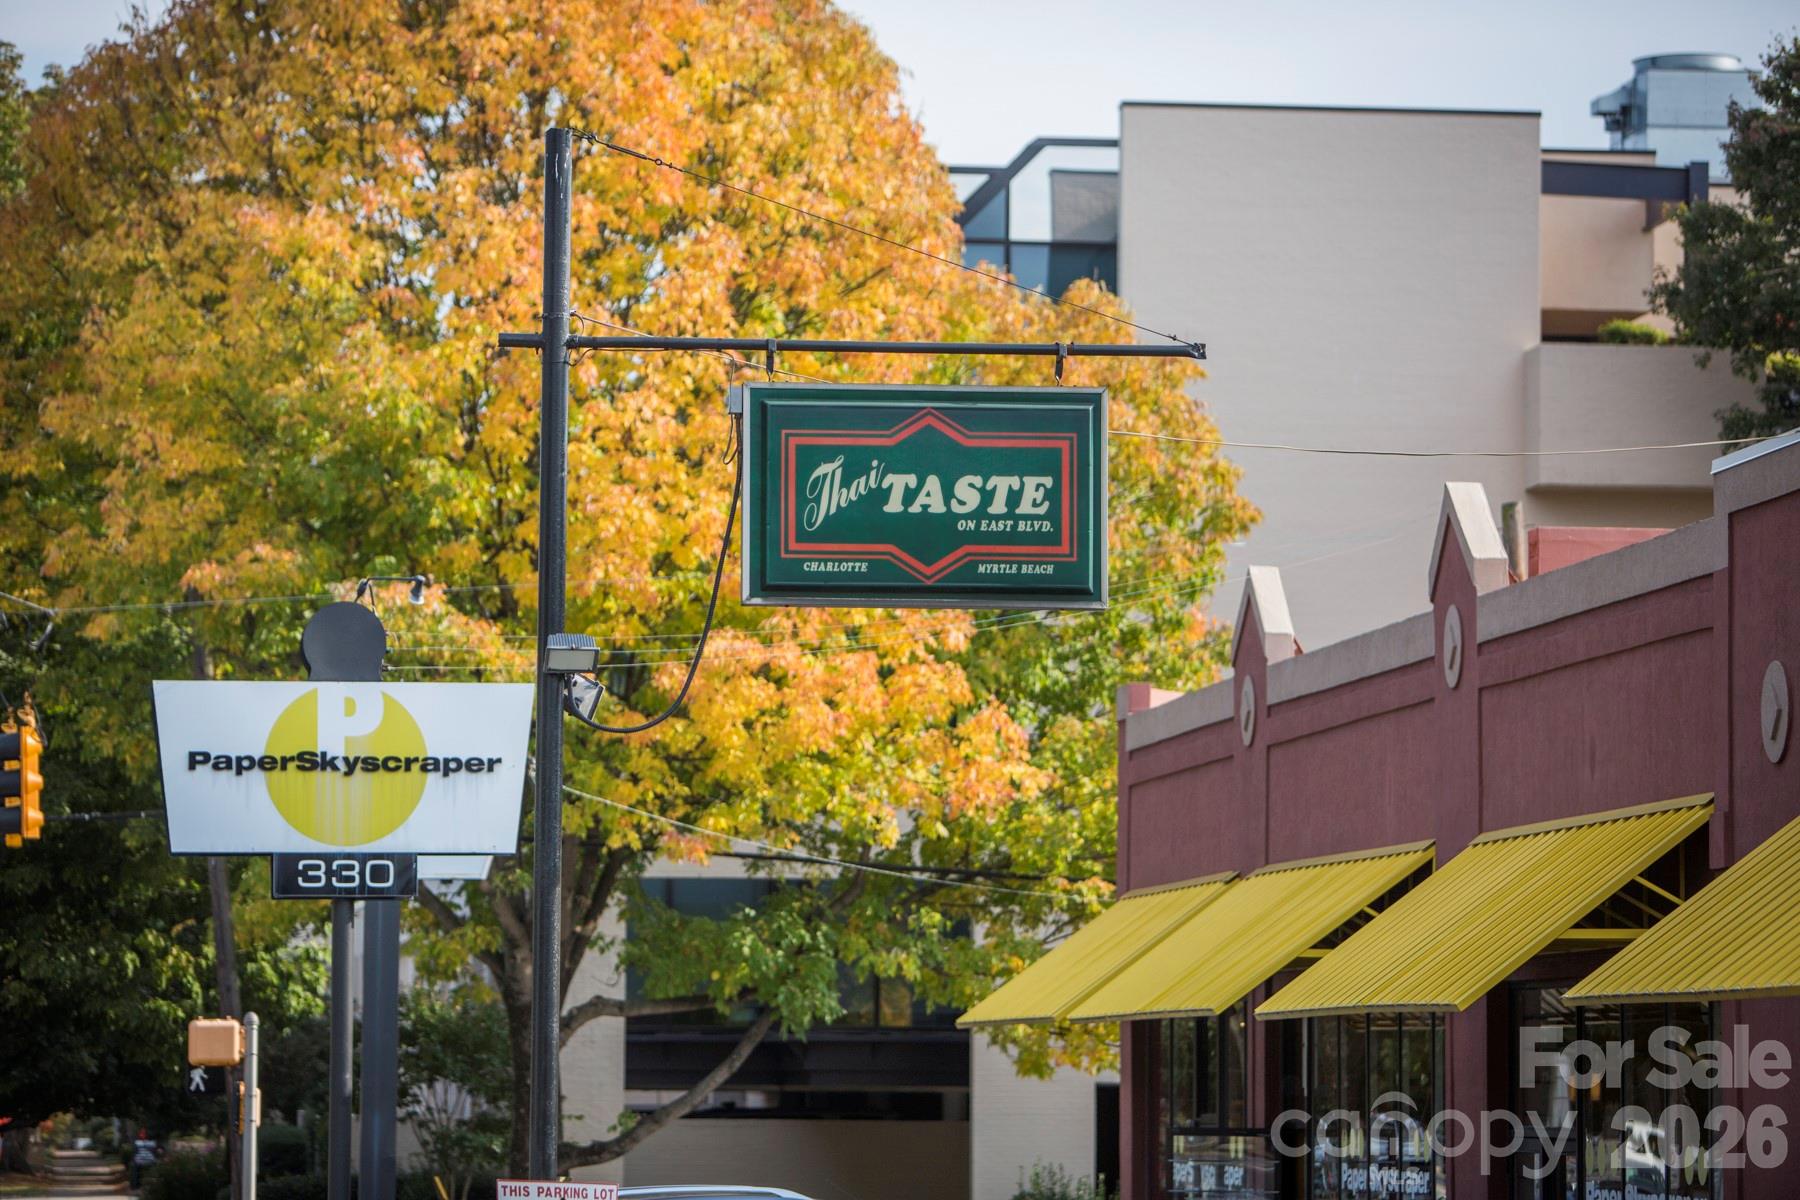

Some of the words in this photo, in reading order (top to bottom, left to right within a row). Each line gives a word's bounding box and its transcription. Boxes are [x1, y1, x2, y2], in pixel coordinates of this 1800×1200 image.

[804, 455, 885, 531] Thai
[881, 473, 1054, 515] TASTE
[957, 519, 976, 532] ON
[979, 519, 1014, 532] EAST
[1017, 520, 1054, 533] BLVD.
[803, 561, 869, 573] CHARLOTTE
[977, 563, 1018, 575] MYRTLE
[1021, 564, 1055, 576] BEACH
[187, 749, 503, 777] PaperSkyscraper
[297, 859, 396, 889] 330
[501, 1185, 530, 1197] THIS
[537, 1186, 588, 1199] PARKING
[593, 1188, 614, 1200] LOT
